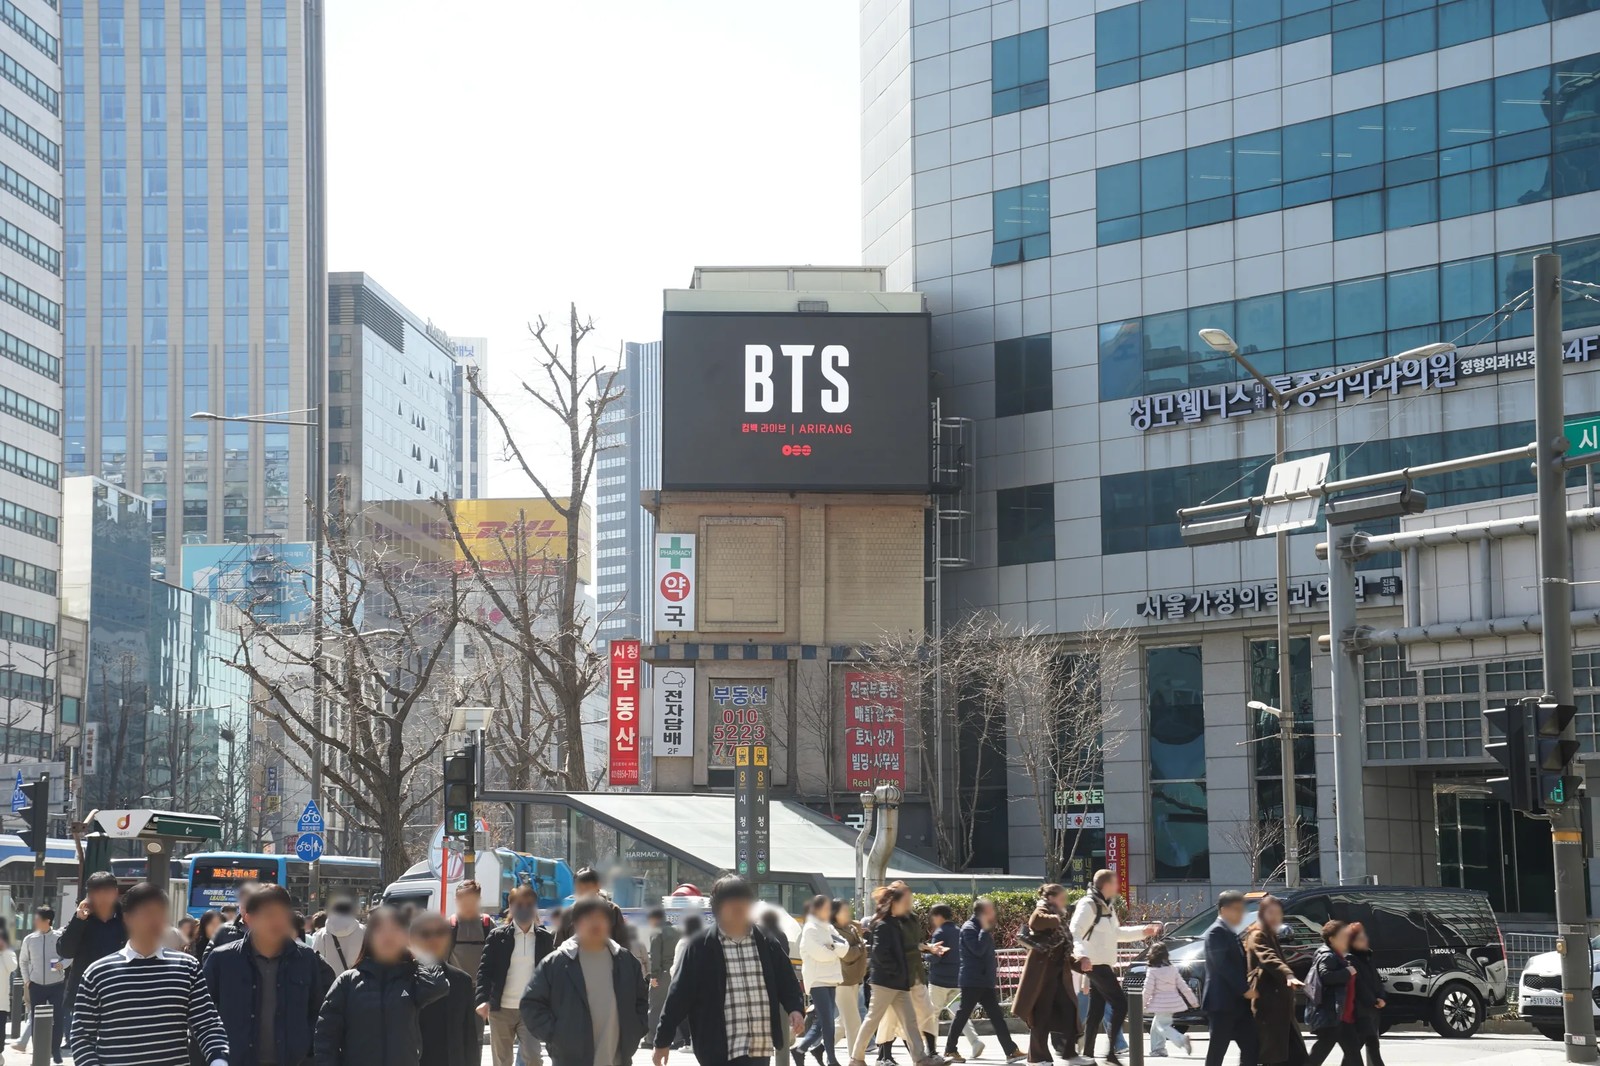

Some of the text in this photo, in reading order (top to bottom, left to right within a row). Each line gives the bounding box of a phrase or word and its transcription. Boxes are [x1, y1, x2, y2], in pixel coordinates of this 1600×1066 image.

[744, 344, 850, 413] BTS
[1129, 383, 1254, 431] 성모웰니스
[1565, 335, 1599, 362] 4F
[760, 423, 787, 433] 라이브
[799, 424, 853, 434] ARIRANG
[475, 519, 560, 539] DHL
[664, 576, 687, 627] 약국
[613, 644, 639, 659] 시청
[713, 685, 768, 706] 부동산
[615, 667, 637, 752] 부동산
[663, 690, 684, 746] 전자담배
[723, 708, 758, 725] 010
[713, 724, 766, 740] 5223
[667, 747, 679, 755] 2F
[712, 740, 765, 757] 77
[740, 771, 746, 782] 8
[758, 770, 764, 782] 8
[852, 778, 871, 787] Real
[453, 812, 468, 831] 18
